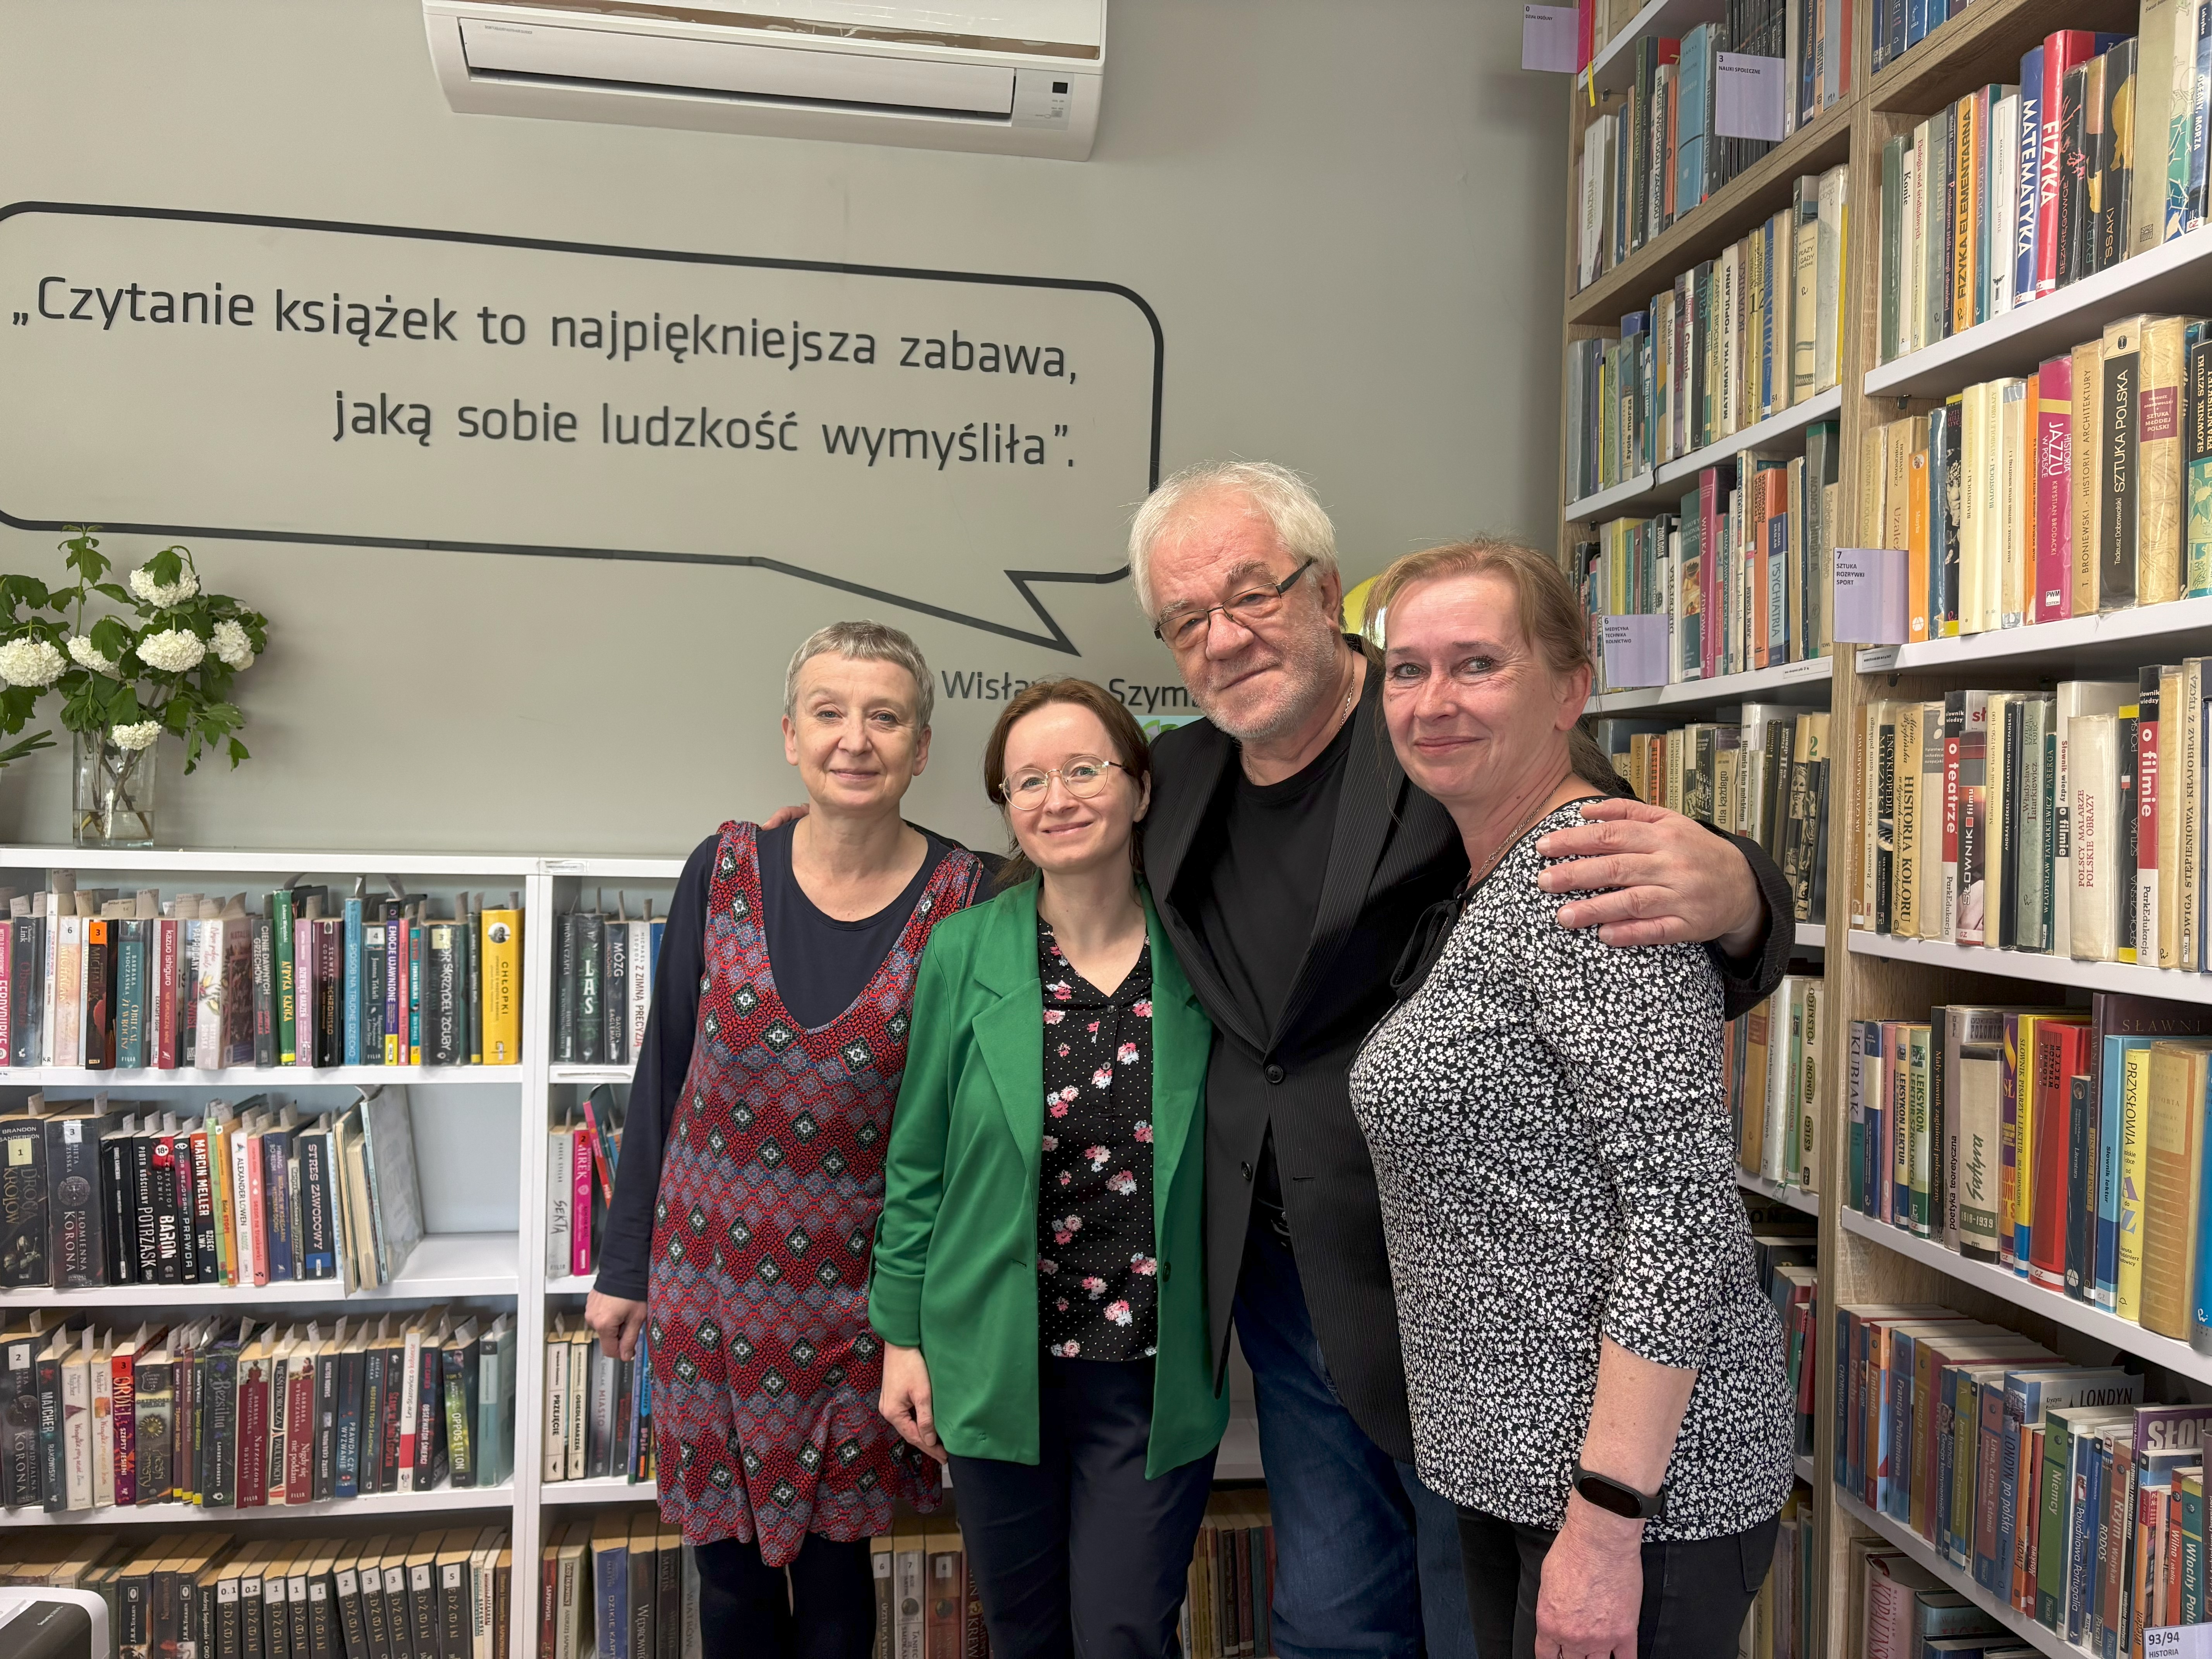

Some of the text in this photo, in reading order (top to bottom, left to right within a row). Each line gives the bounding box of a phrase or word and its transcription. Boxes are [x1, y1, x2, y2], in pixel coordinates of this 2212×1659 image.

[2193, 74, 2205, 151] OCEANY, MORZA
[2017, 99, 2038, 258] MATEMATYKA
[2040, 120, 2059, 207] FIZYKA
[1903, 170, 1911, 206] Konie
[1958, 108, 1972, 299] FIZYKA ELEMENTARNA
[1799, 245, 1814, 257] PŁAZY
[2059, 180, 2069, 275] BEZKRĘGOWCE
[2087, 219, 2095, 264] RYBY
[1800, 253, 1815, 264] GADY
[12, 276, 1078, 385] „Czytanie książek to najpiękniejsza zabawa,
[2115, 369, 2128, 429] POLSKA
[2145, 418, 2171, 426] MŁODEJ
[2147, 411, 2169, 419] SZTUKA
[333, 390, 1074, 471] jaką sobie ludzkość wymyśliła”.
[2042, 435, 2048, 444] W
[2049, 422, 2064, 476] JAZZU
[2147, 424, 2169, 432] POLSKI
[2063, 433, 2071, 473] HISTORIA
[2114, 433, 2126, 493] SZTUKA
[1836, 551, 1842, 559] 7
[2081, 510, 2090, 573] BRONIEWSKI
[1771, 562, 1781, 638] PSYCHIATRIA
[2046, 590, 2060, 598] PWM
[2082, 579, 2089, 587] T.
[942, 671, 1035, 700] Wisła
[1109, 679, 1200, 713] Szym
[1810, 736, 1818, 756] 2
[1717, 770, 1727, 824] dla każdego
[1947, 743, 1959, 833] o teatrze
[2141, 729, 2157, 817] o filmie
[2059, 807, 2066, 816] o
[1901, 775, 1914, 923] HISTORIA KOLORU
[2058, 819, 2068, 857] filmie
[2185, 806, 2193, 888] STĘPIENIOWA
[1963, 829, 1973, 906] SŁOWNIK
[1945, 876, 1953, 936] ParkEdukacja
[2141, 886, 2151, 956] ParkEdukacja
[165, 956, 173, 986] ishiguro
[613, 942, 625, 977] MÓZG
[501, 961, 509, 1015] CHŁOPKI
[583, 960, 595, 1014] LAS
[1807, 987, 1815, 1045] POLSKIEGO
[1805, 1056, 1815, 1104] HUMORU
[1850, 1033, 1859, 1116] KUBIAK
[2125, 1061, 2137, 1146] PRZYSŁOWIA
[194, 1139, 210, 1216] MARCIN MELLER
[309, 1144, 323, 1250] STRES ZAWODOWY
[551, 1200, 568, 1235] SEKTA
[1949, 1189, 1957, 1231] poetyka
[1961, 1211, 1994, 1228] 1918-1939
[64, 1211, 76, 1272] KORONA
[137, 1207, 156, 1268] POTRZASK
[159, 1215, 177, 1259] BARON
[182, 1218, 192, 1268] PRAWDA
[41, 1391, 54, 1432] MAJCHER
[2080, 1388, 2132, 1407] LONDYN
[452, 1412, 464, 1470] OPPOSITION
[2001, 1435, 2014, 1534] LONDYN po polsku
[2049, 1470, 2061, 1516] Niemcy
[2099, 1523, 2107, 1562] RODOS
[2112, 1499, 2122, 1541] Rzym
[2171, 1530, 2179, 1557] Wilno
[2071, 1506, 2085, 1612] Południowa Portugalia
[2185, 1542, 2196, 1590] Włochy
[221, 1587, 236, 1595] 0.1
[2148, 1632, 2179, 1646] 93/94
[2149, 1649, 2179, 1658] HISTORIA
